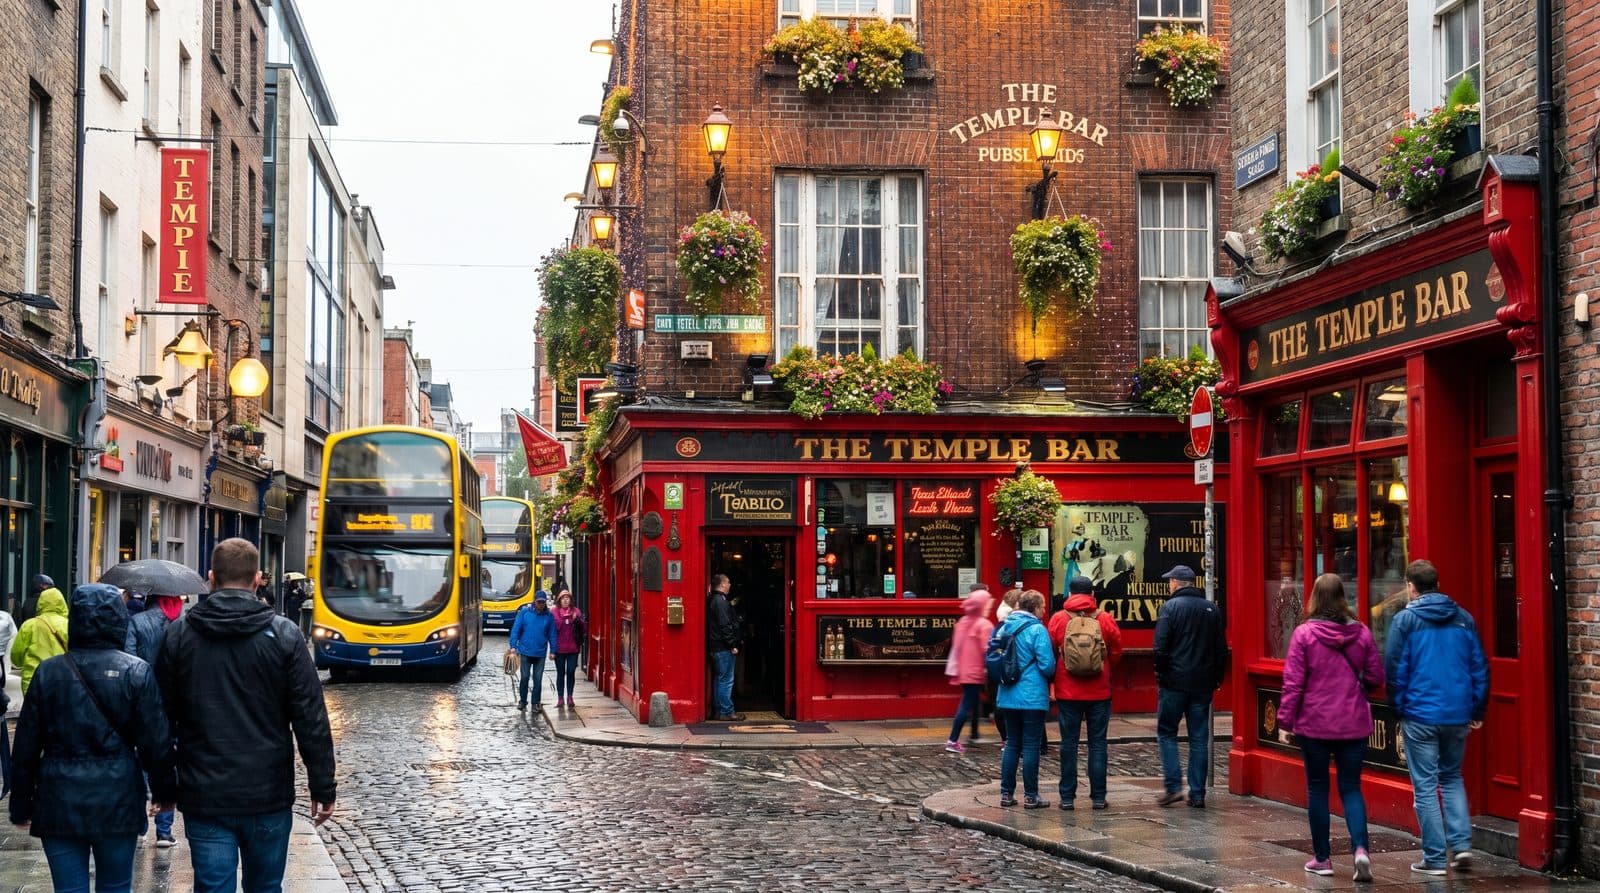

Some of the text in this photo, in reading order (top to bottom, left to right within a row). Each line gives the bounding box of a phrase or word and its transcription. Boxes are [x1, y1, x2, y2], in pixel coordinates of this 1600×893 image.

[1001, 83, 1057, 104] THE
[1058, 110, 1109, 147] BAR
[1268, 270, 1472, 365] THE TEMPLE BAR
[794, 438, 1120, 462] THE TEMPLE BAR
[1084, 511, 1135, 523] TEMPLE
[1100, 524, 1130, 536] BAR
[847, 618, 874, 628] THE
[878, 618, 928, 628] TEMPLE
